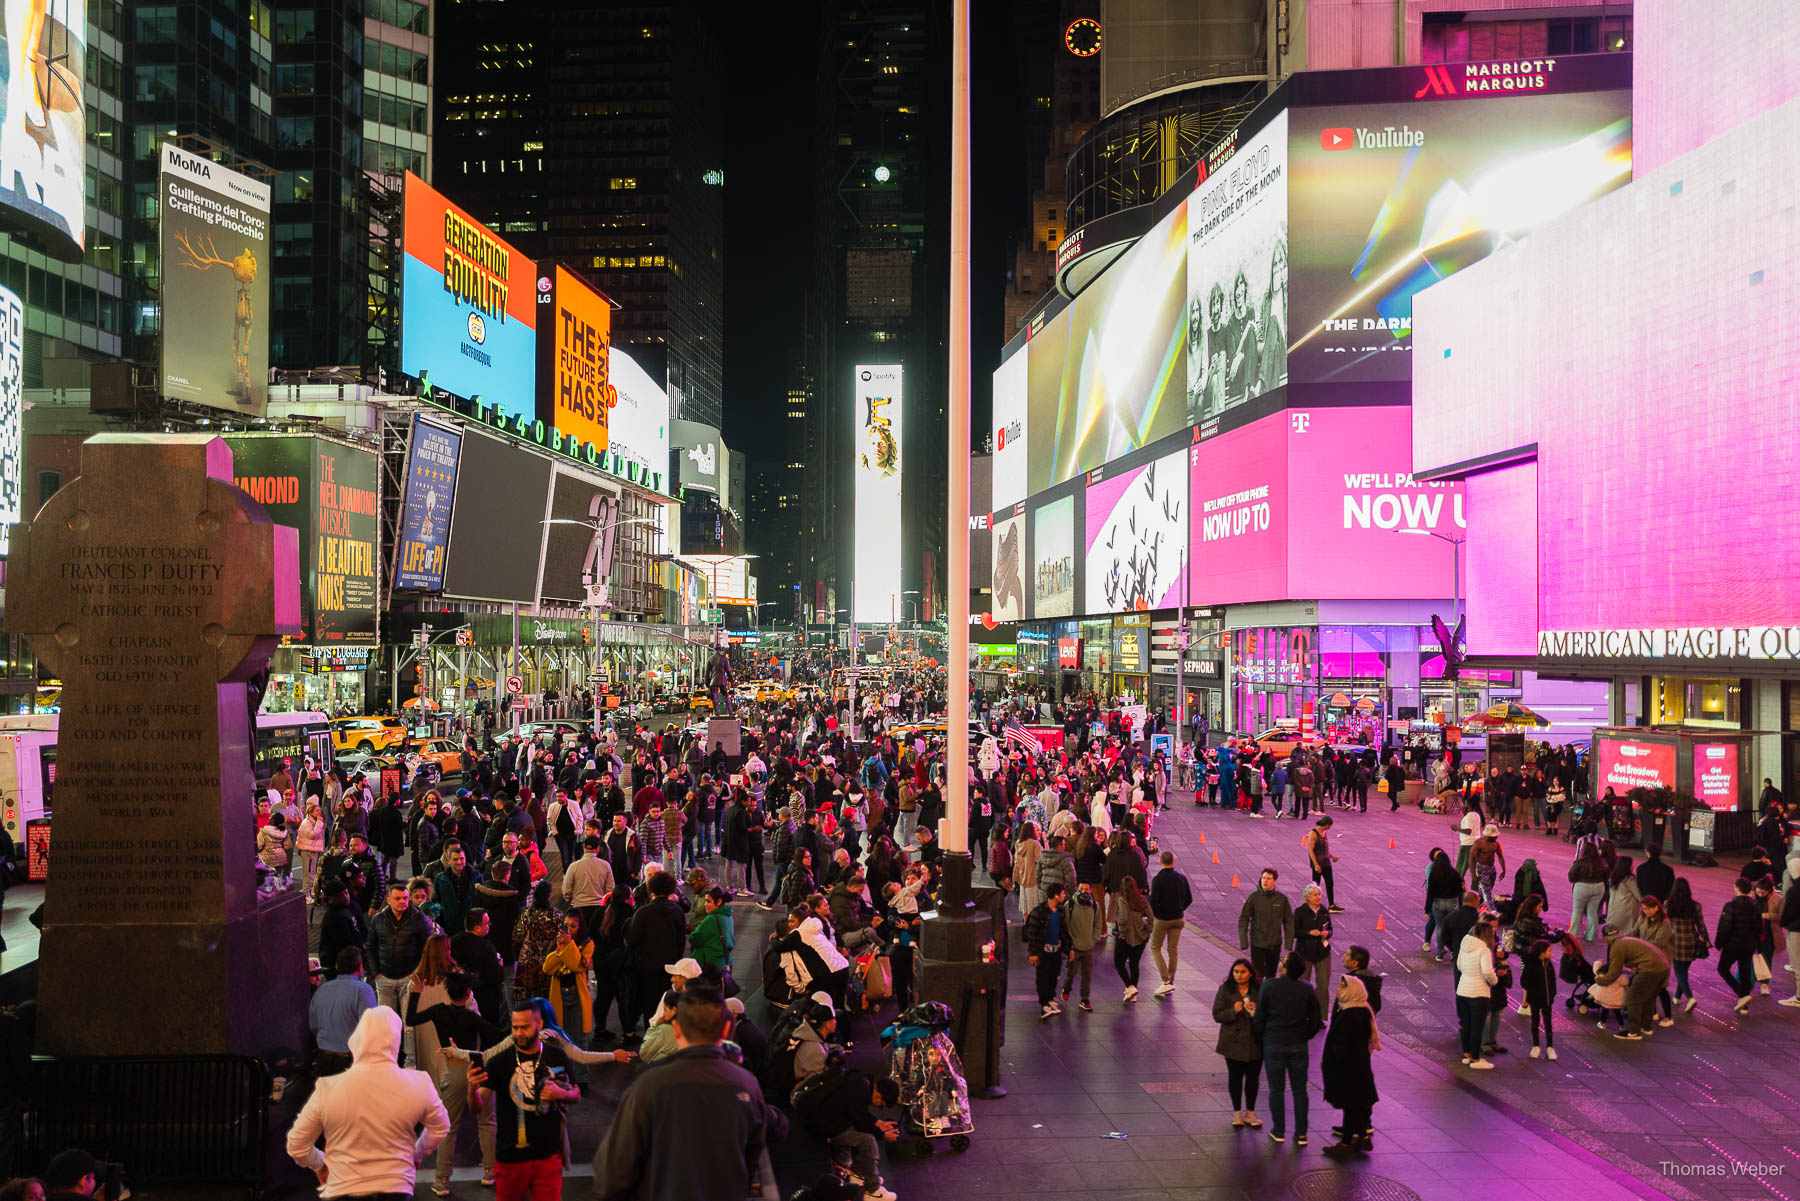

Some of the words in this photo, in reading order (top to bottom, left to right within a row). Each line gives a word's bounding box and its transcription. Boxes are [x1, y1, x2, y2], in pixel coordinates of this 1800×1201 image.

[1466, 60, 1556, 77] MARRIOTT
[1466, 75, 1545, 92] MARQUIS
[1209, 129, 1239, 162] MARRIOTT
[1356, 125, 1424, 149] YouTube
[169, 150, 211, 180] MoMA
[1209, 146, 1236, 174] MARQUIS
[228, 181, 242, 193] Now
[252, 192, 266, 202] view
[1201, 178, 1228, 222] PINK
[1230, 145, 1270, 198] FLOYD
[168, 182, 222, 212] Guillermo
[223, 205, 238, 219] del
[240, 210, 265, 230] Toro:
[1193, 226, 1204, 244] THE
[1204, 216, 1221, 235] DARK
[1222, 203, 1234, 222] SIDE
[1236, 195, 1244, 210] OF
[1246, 183, 1258, 203] THE
[1260, 165, 1280, 191] MOON
[168, 197, 213, 224] Crafting
[215, 214, 264, 240] Pinocchio
[445, 208, 509, 282] GENERATION
[444, 246, 508, 325] EQUALITY
[538, 294, 551, 304] LG
[560, 306, 596, 365] THE
[1322, 318, 1358, 331] THE
[1363, 317, 1412, 330] DARK
[460, 341, 492, 368] #ACTFOREQUAL
[560, 348, 595, 385] FUTURE
[597, 332, 605, 428] MANY
[560, 370, 594, 421] HAS
[471, 394, 545, 444] 1540
[550, 427, 662, 490] BROADWAY
[320, 454, 335, 483] THE
[1344, 473, 1393, 488] WE'LL
[1395, 473, 1422, 488] PA
[320, 481, 338, 508] NEIL
[340, 484, 376, 516] DIAMOND
[1250, 485, 1269, 500] PHONE
[320, 506, 352, 537] MUSICAL
[1203, 511, 1232, 542] NOW
[1233, 507, 1250, 536] UP
[1251, 502, 1270, 532] TO
[1343, 494, 1444, 529] NOW
[71, 547, 148, 559] LIEUTENANT
[151, 547, 212, 560] COLONEL
[318, 536, 324, 572] A
[326, 536, 373, 577] BEAUTIFUL
[402, 541, 427, 572] LIFE
[425, 550, 434, 569] OF
[432, 545, 444, 574] PI
[61, 563, 136, 579] FRANCIS
[162, 564, 224, 580] DUFFY
[70, 584, 94, 595] MAY
[98, 584, 104, 595] 2
[172, 585, 185, 596] 26
[188, 585, 214, 596] 1932
[317, 573, 345, 611] NOISE
[80, 605, 147, 617] CATHOLIC
[154, 605, 201, 617] PRIEST
[109, 636, 172, 648] CHAPLAIN
[534, 620, 556, 644] Disney
[1538, 630, 1654, 658] AMERICAN
[1665, 628, 1750, 658] EAGLE
[80, 655, 113, 666] 165TH
[336, 648, 368, 658] LUGGAGE
[96, 671, 122, 682] OLD
[126, 671, 154, 682] 69TH
[1184, 661, 1214, 674] SEPHORA
[81, 704, 89, 715] A
[96, 704, 121, 715] LIFE
[126, 704, 143, 715] OF
[148, 704, 200, 715] SERVICE
[128, 718, 150, 727] FOR
[74, 729, 105, 740] GOD
[109, 729, 137, 740] AND
[142, 729, 203, 741] COUNTRY
[70, 762, 115, 772] SPANISH
[118, 762, 177, 773] AMERICAN
[180, 762, 206, 772] WAR
[1614, 763, 1626, 773] Get
[1627, 764, 1659, 779] Broadway
[1701, 774, 1731, 782] Broadway
[55, 778, 80, 787] NEW
[85, 778, 115, 787] YORK
[119, 778, 176, 787] NATIONAL
[179, 778, 220, 787] GUARD
[1607, 774, 1628, 785] tickets
[1629, 776, 1636, 785] in
[1636, 778, 1664, 790] seconds.
